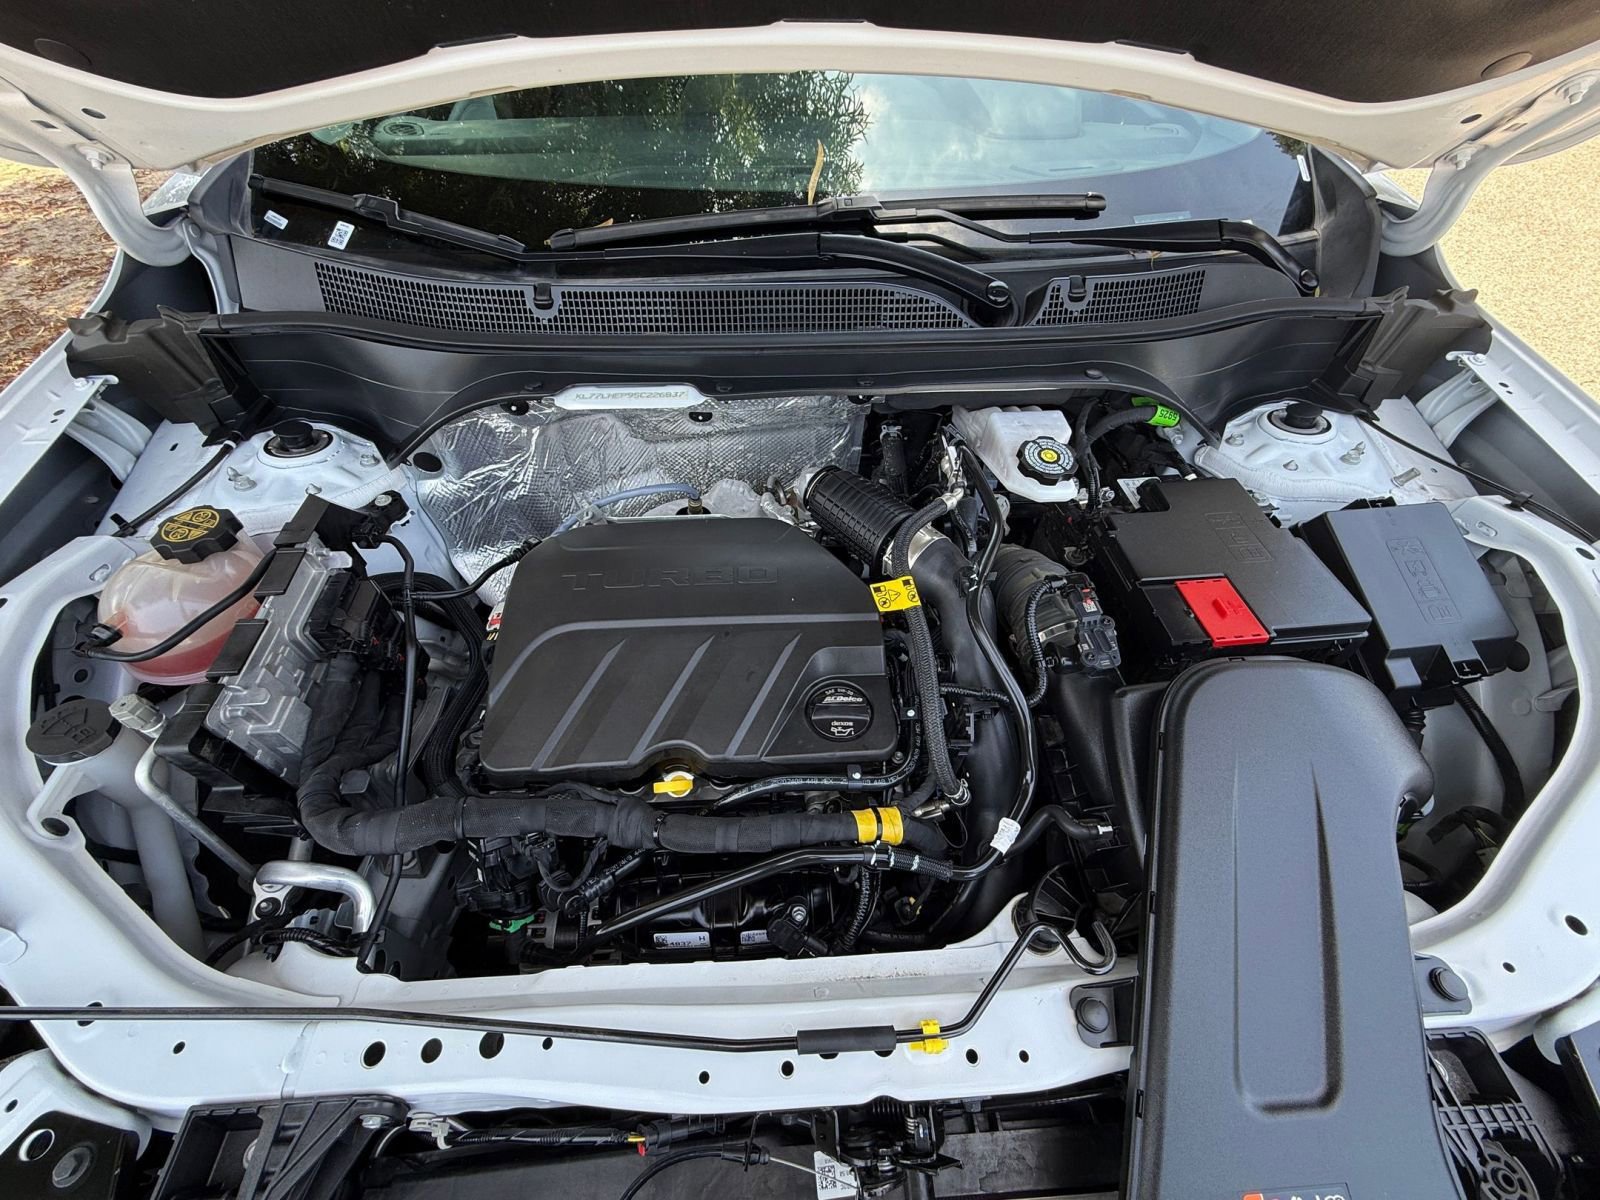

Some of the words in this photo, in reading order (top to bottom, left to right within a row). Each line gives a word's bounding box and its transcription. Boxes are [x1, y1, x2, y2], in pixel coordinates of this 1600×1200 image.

[1159, 408, 1178, 421] 5925
[561, 566, 780, 590] TURBO
[822, 695, 864, 704] ACDelco
